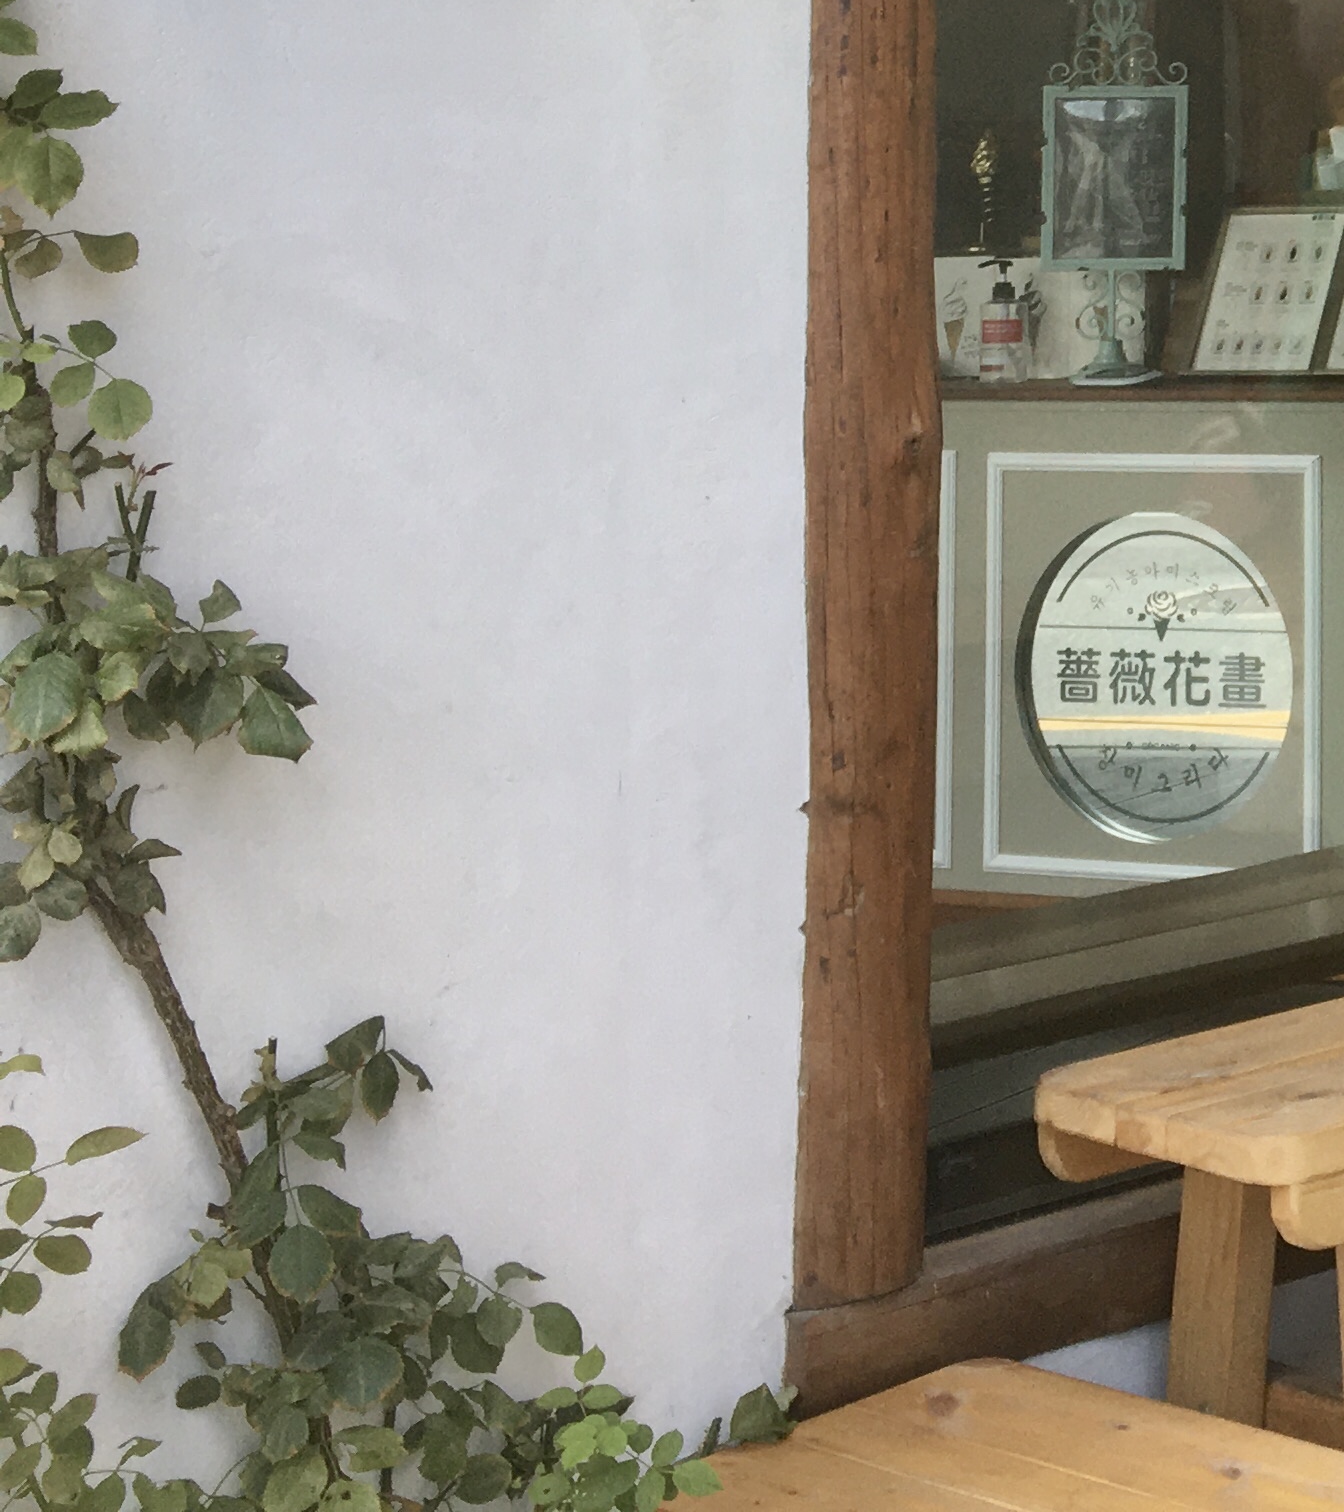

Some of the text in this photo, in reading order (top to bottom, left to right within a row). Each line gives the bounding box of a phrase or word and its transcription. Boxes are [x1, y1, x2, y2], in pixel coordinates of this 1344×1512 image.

[1055, 646, 1267, 709] 薔薇花畫
[1098, 743, 1231, 793] 장미그리다
